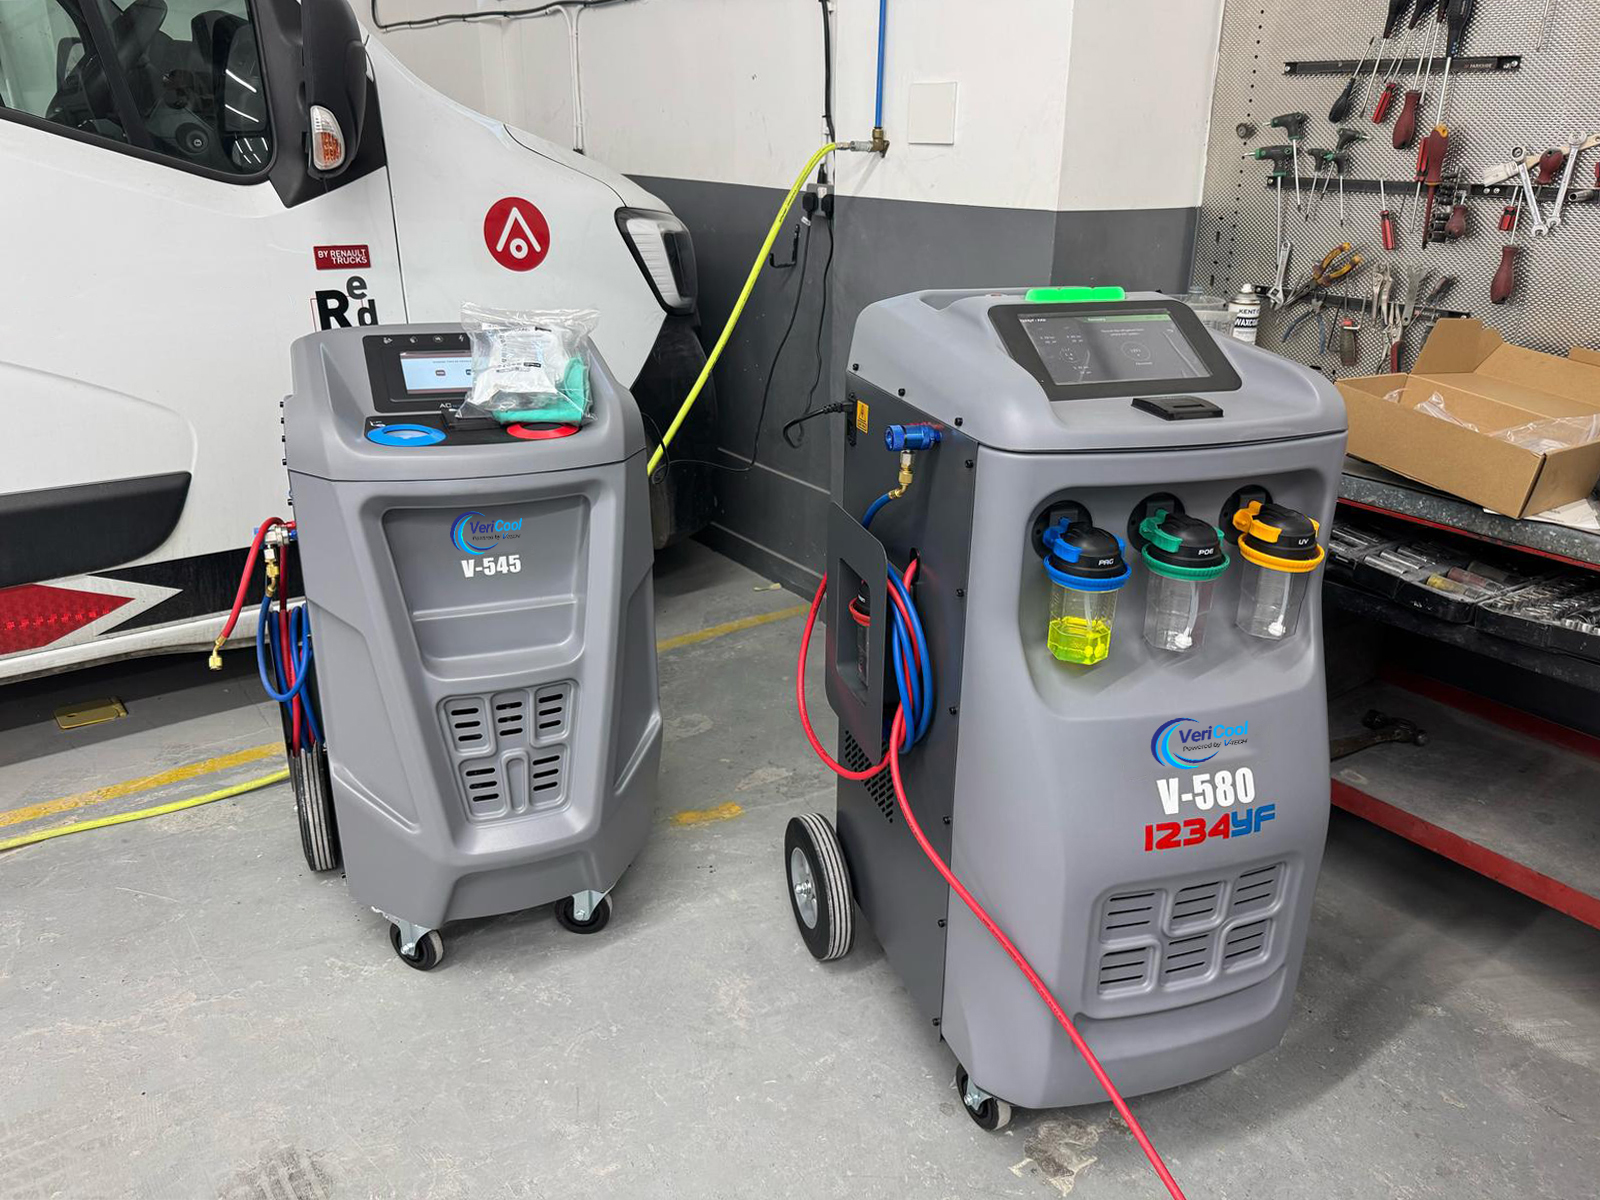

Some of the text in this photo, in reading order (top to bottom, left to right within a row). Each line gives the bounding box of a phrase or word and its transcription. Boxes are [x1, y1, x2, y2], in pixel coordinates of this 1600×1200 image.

[317, 248, 366, 259] BY RENAULT
[331, 255, 368, 265] TRUCKS
[469, 517, 523, 534] VeriCool
[1298, 538, 1309, 546] UV
[1198, 547, 1215, 556] POE
[460, 554, 522, 578] V-545
[1098, 558, 1114, 566] PAG
[1178, 720, 1249, 744] VeriCool
[1182, 738, 1249, 752] Powered by V-TECH
[1156, 766, 1256, 815] V-580
